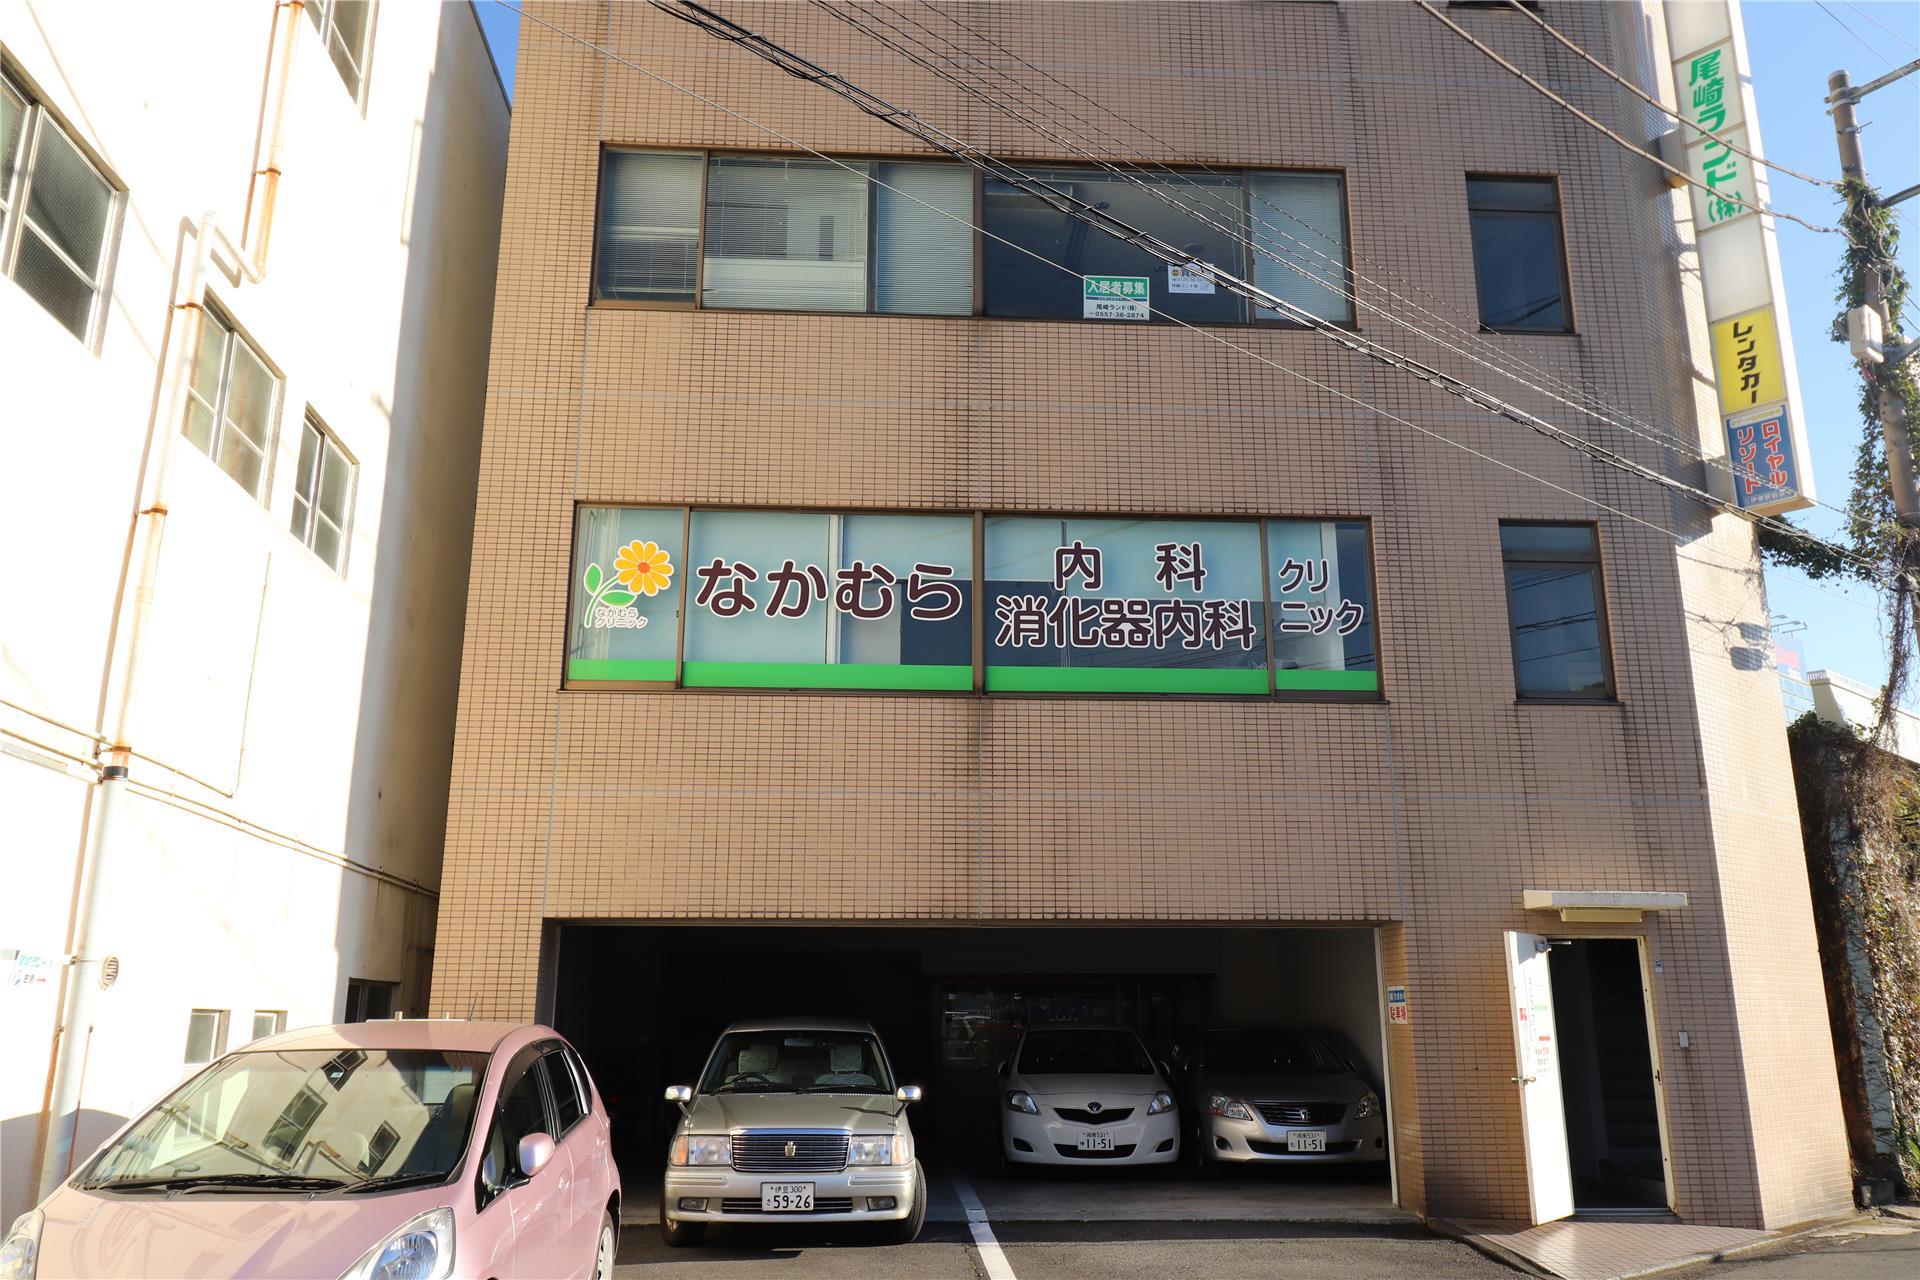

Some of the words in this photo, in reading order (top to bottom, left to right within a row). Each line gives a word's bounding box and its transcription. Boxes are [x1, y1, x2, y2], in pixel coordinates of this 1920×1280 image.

[1087, 280, 1145, 295] 入居者募集
[1733, 321, 1760, 404] レンタカー
[1737, 426, 1761, 494] リゾート
[1761, 419, 1788, 489] ロイヤル
[695, 557, 963, 621] なかむら
[1279, 557, 1329, 594] クリ
[595, 607, 639, 618] なかむら
[595, 616, 649, 628] クリニック
[995, 595, 1256, 650] 消化器内科
[1280, 599, 1364, 636] ニック
[1087, 1138, 1111, 1149] 11-51
[1297, 1139, 1322, 1150] 11-51
[773, 1194, 811, 1209] 59-26
